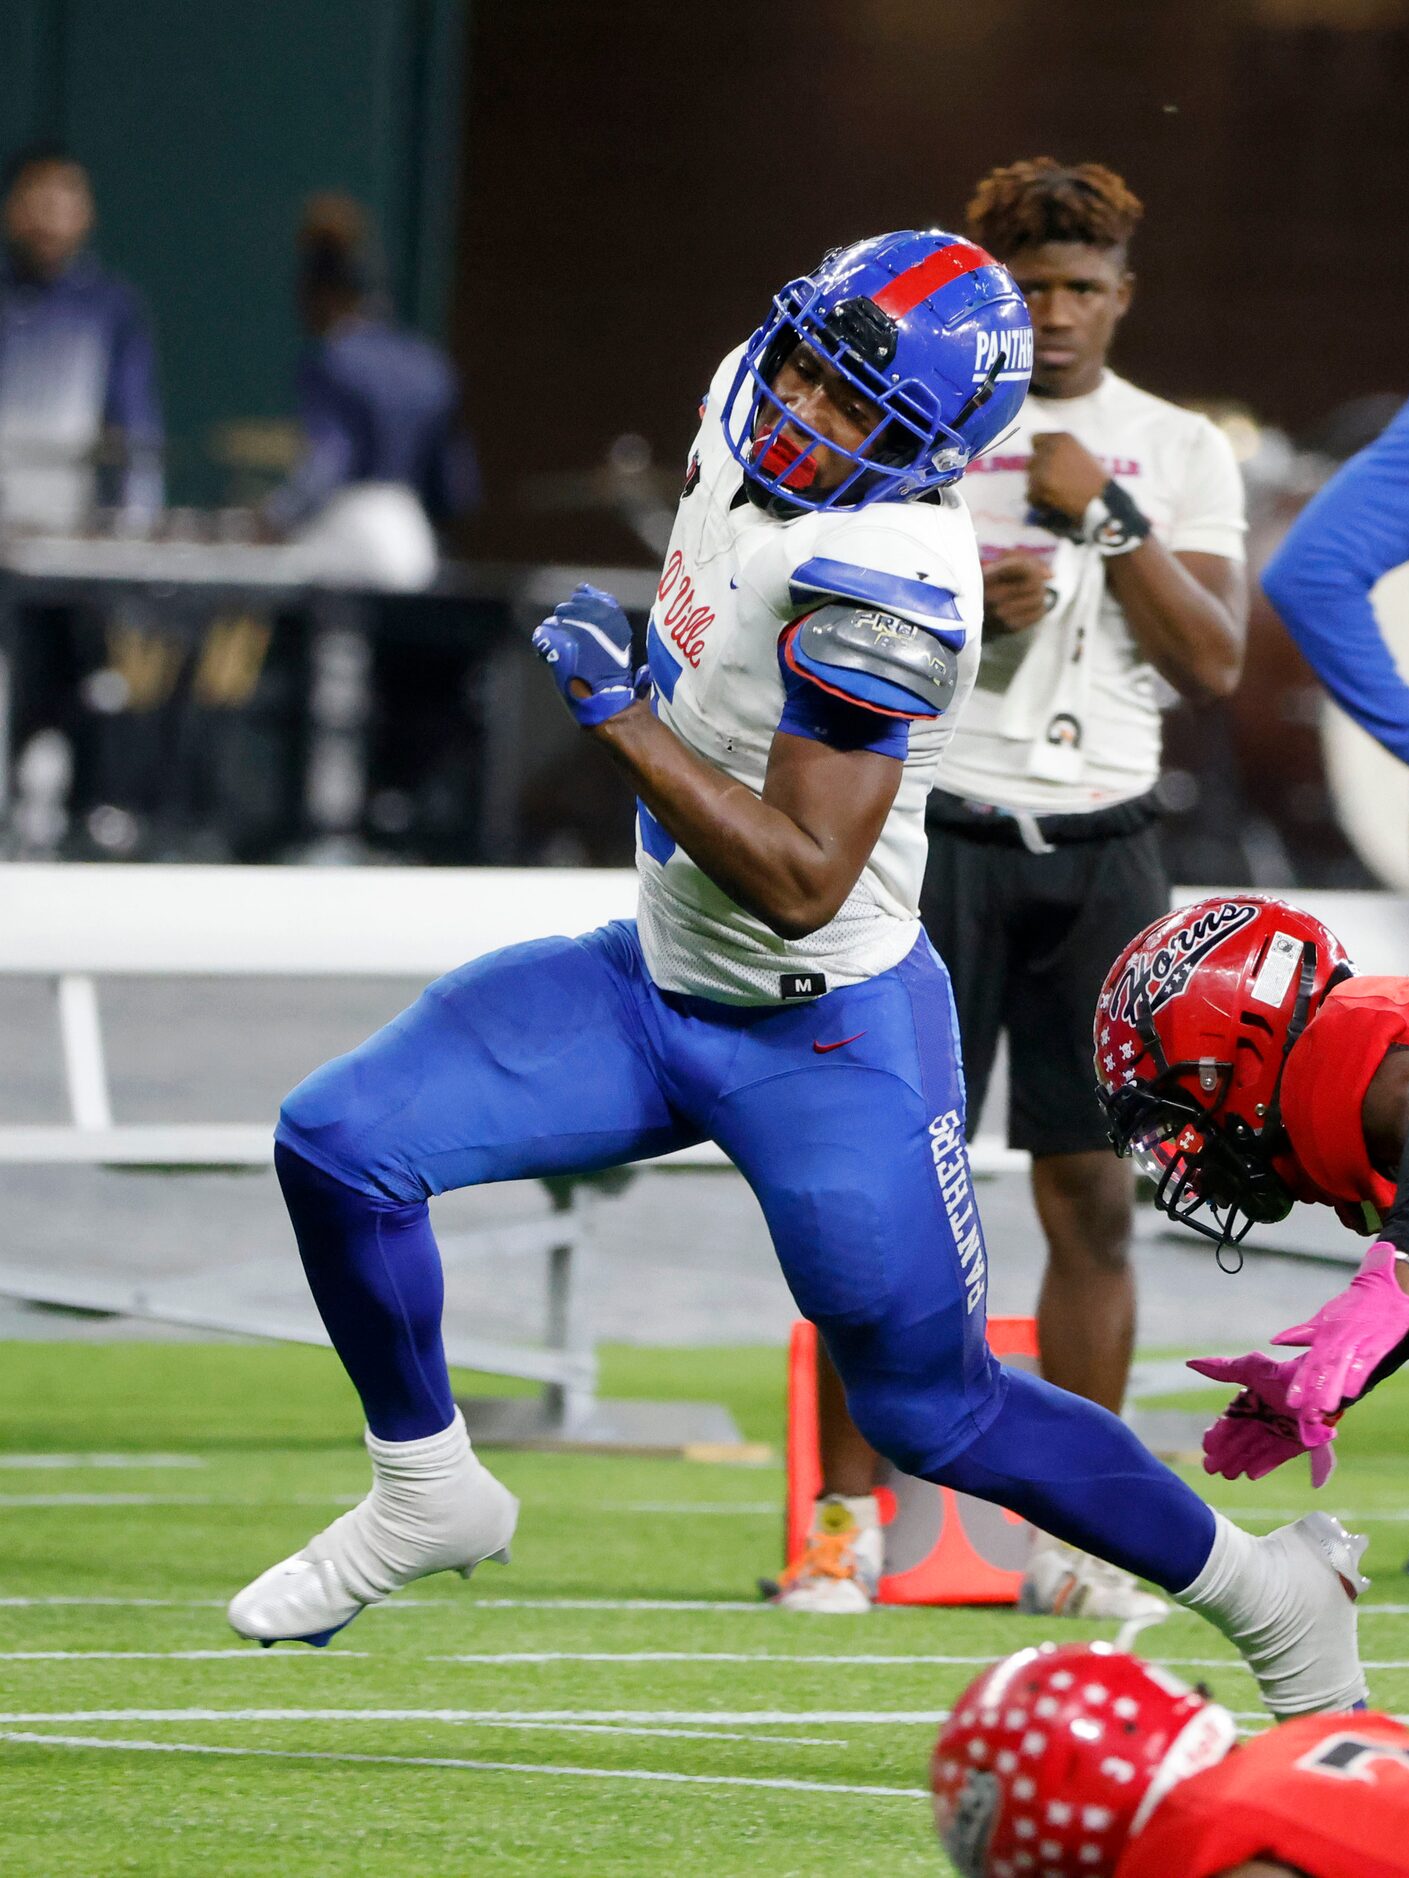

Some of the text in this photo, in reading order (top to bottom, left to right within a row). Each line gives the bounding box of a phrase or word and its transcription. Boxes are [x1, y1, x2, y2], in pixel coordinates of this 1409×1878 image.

[794, 978, 812, 993] M
[1109, 902, 1238, 1027] Horns
[929, 1109, 985, 1315] PANTHERS
